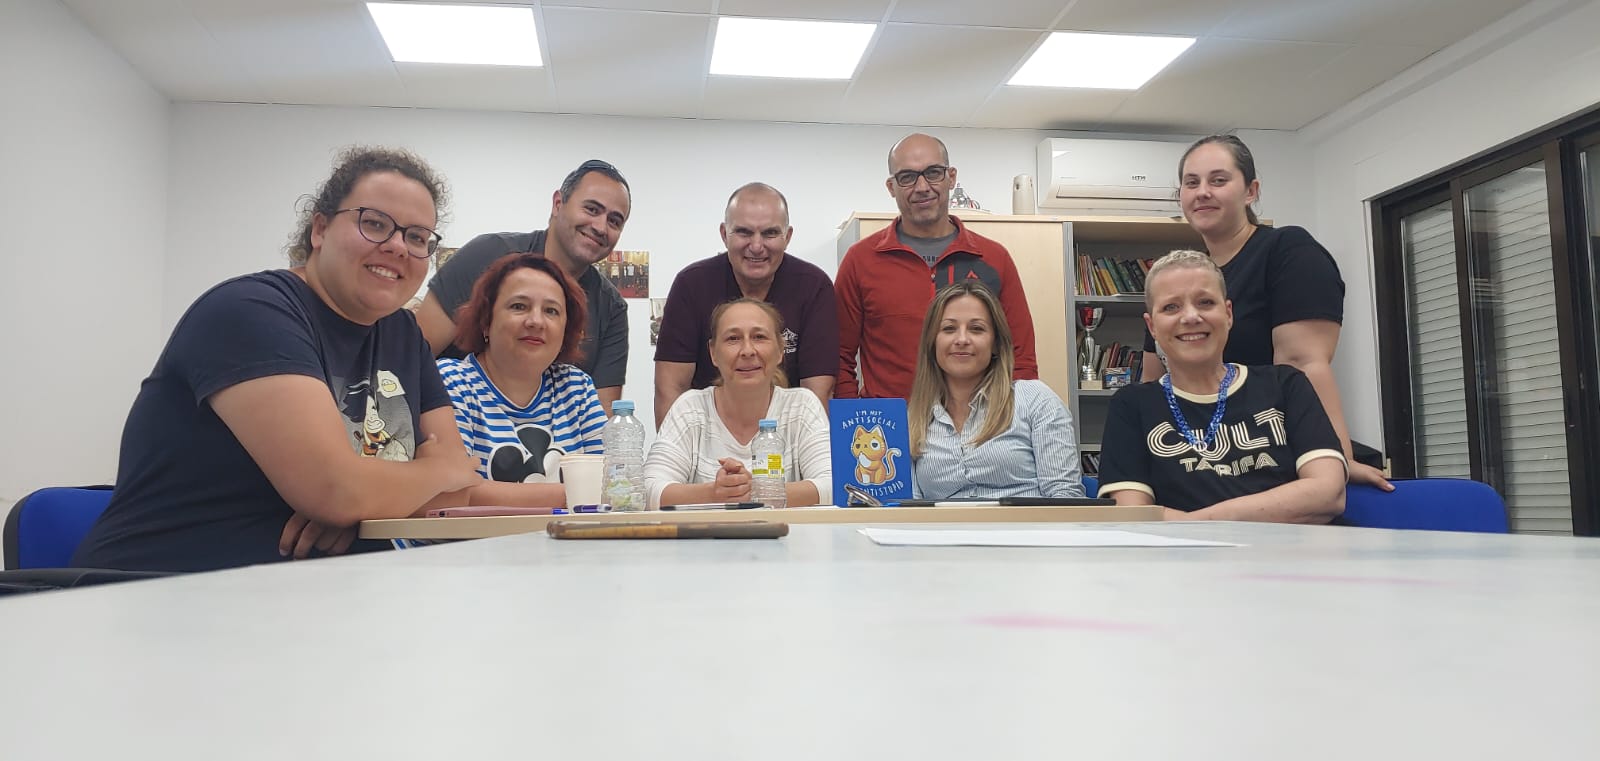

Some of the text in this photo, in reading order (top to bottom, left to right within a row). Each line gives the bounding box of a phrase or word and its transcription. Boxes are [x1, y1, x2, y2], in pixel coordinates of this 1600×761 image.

[842, 415, 896, 430] ANTISOCIAL
[1147, 408, 1287, 461] CULT
[1179, 452, 1279, 477] TARIFA
[860, 480, 904, 497] NTISTUPID
